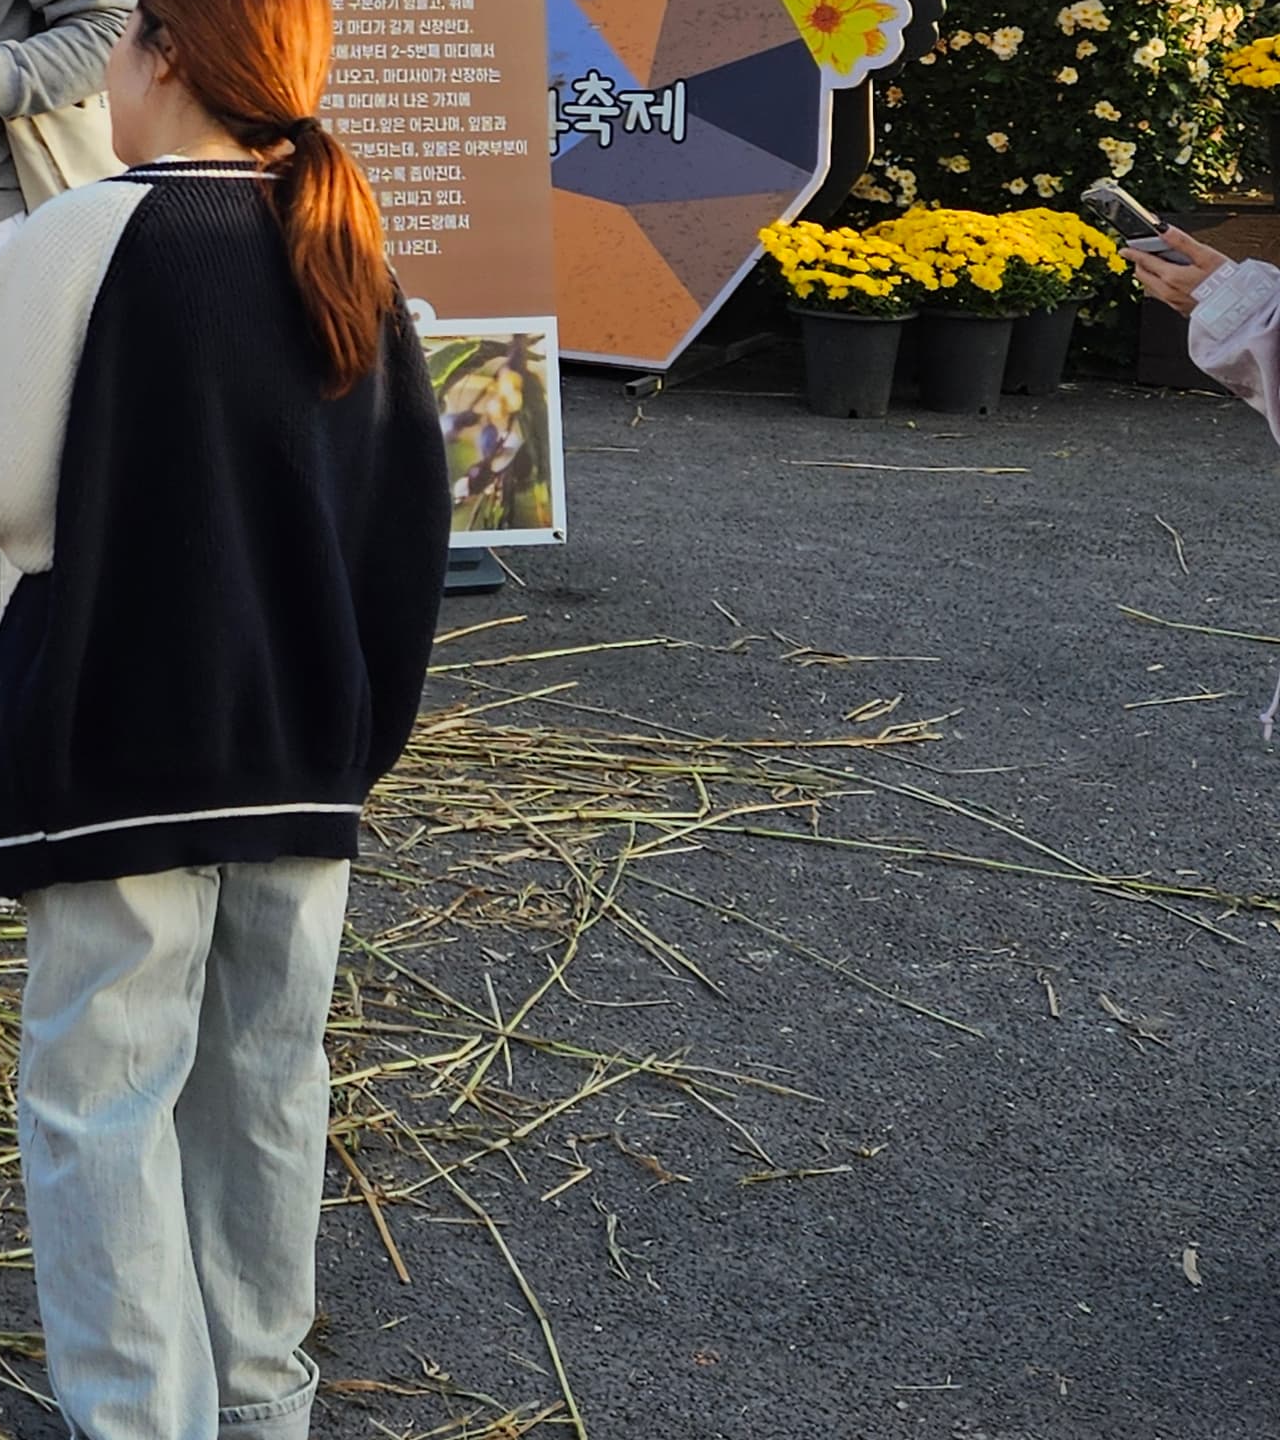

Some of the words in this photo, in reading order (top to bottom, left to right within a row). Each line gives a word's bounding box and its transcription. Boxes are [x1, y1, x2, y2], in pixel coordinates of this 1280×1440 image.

[347, 19, 386, 35] 마디가
[419, 19, 474, 35] 신장한다.
[330, 44, 387, 60] 에서부터
[444, 44, 496, 59] 마디에서
[336, 68, 379, 85] 나오고,
[383, 68, 447, 84] 마디사이가
[450, 68, 502, 84] 신장하는
[348, 93, 400, 109] 마디에서
[403, 93, 429, 109] 나온
[549, 70, 687, 156] 축제
[436, 190, 467, 206] 있다.
[398, 239, 443, 255] 나온다.
